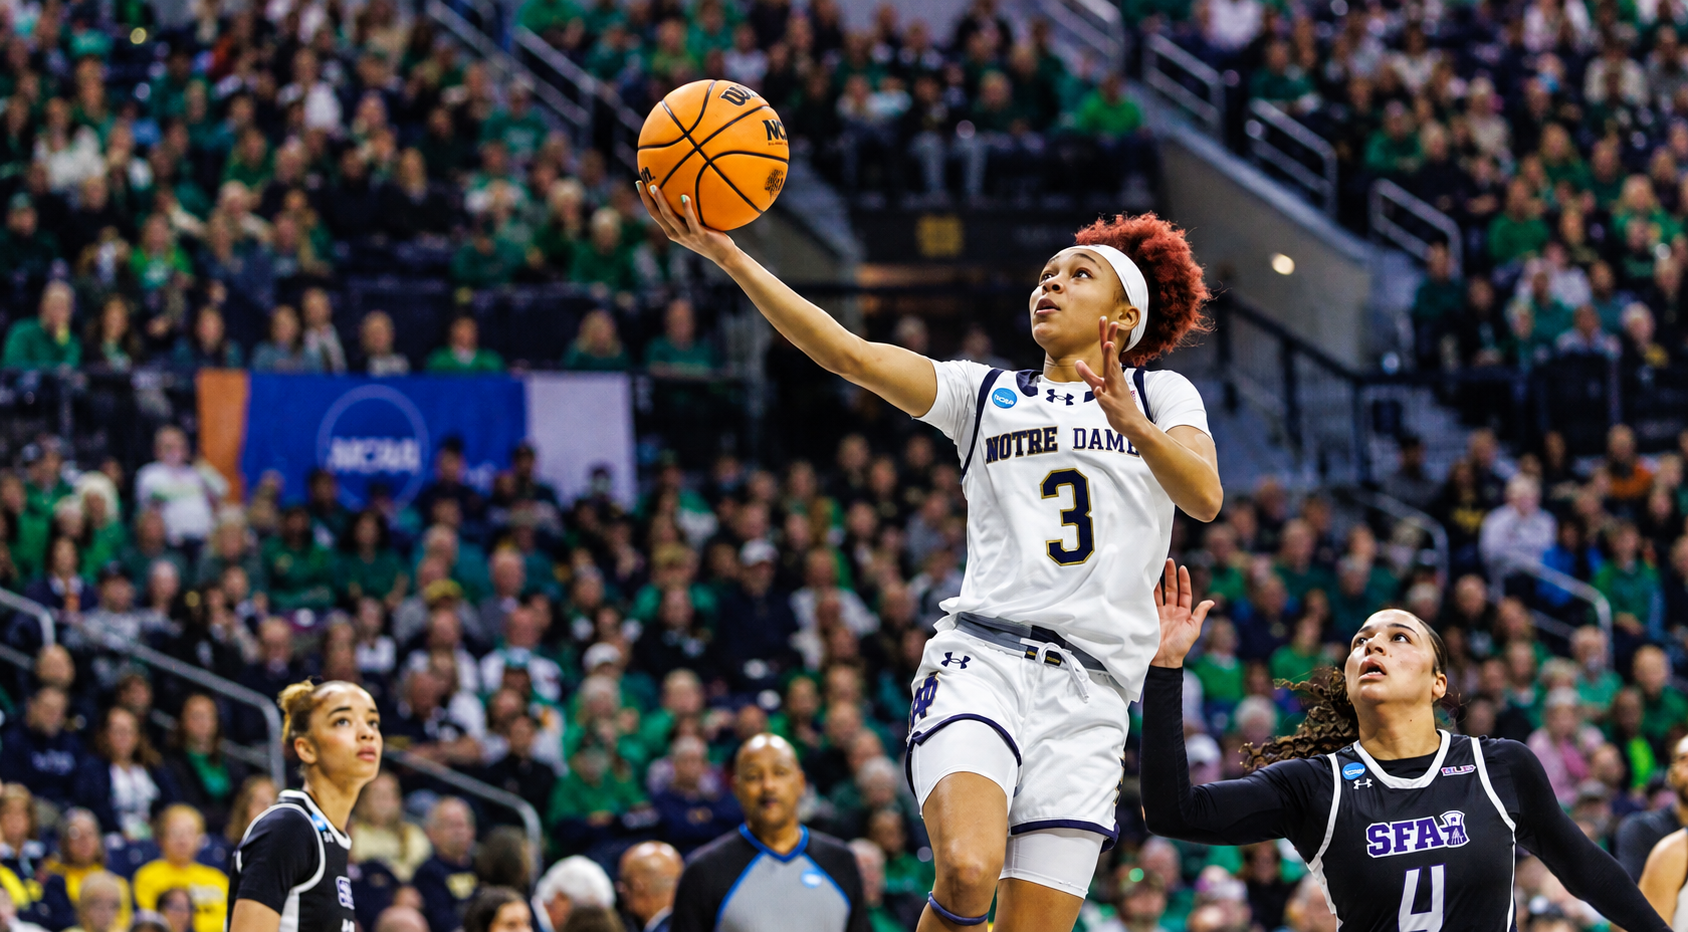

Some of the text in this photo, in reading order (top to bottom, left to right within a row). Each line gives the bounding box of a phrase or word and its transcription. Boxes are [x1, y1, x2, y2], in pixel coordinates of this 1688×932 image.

[986, 426, 1059, 464] NOTRE
[1040, 468, 1095, 566] 3
[1366, 816, 1445, 858] SFA
[1398, 863, 1446, 932] 4
